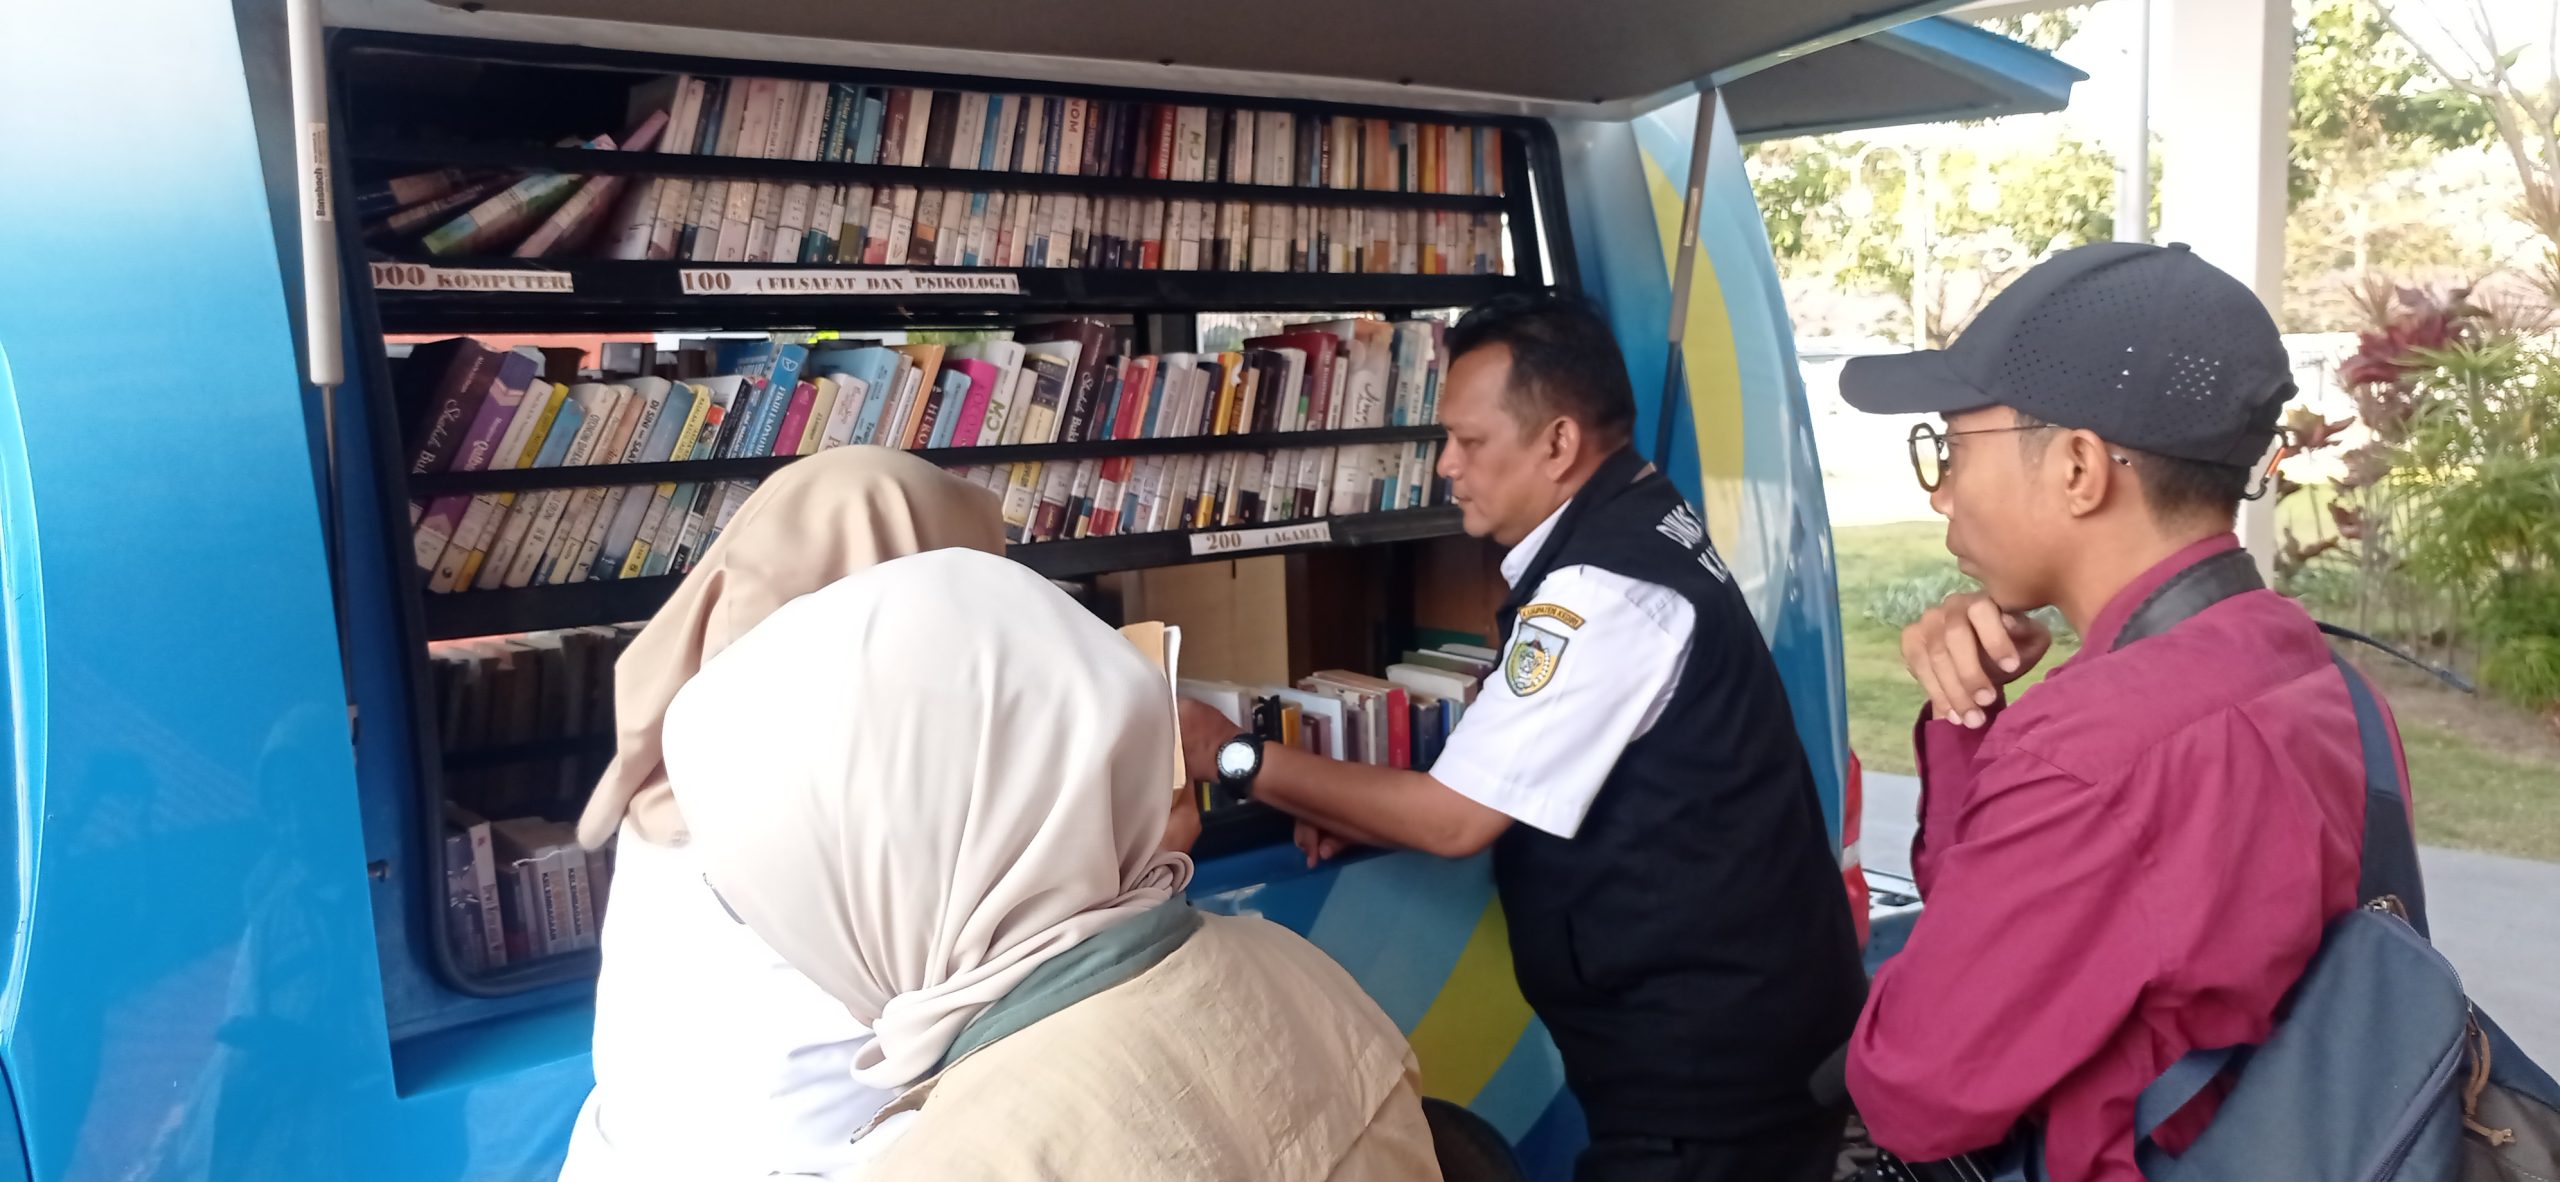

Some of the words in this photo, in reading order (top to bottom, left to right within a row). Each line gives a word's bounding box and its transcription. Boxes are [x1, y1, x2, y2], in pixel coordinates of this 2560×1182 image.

[684, 272, 731, 290] 100
[866, 277, 903, 291] DAN
[917, 403, 939, 445] HERO
[1206, 533, 1242, 550] 200
